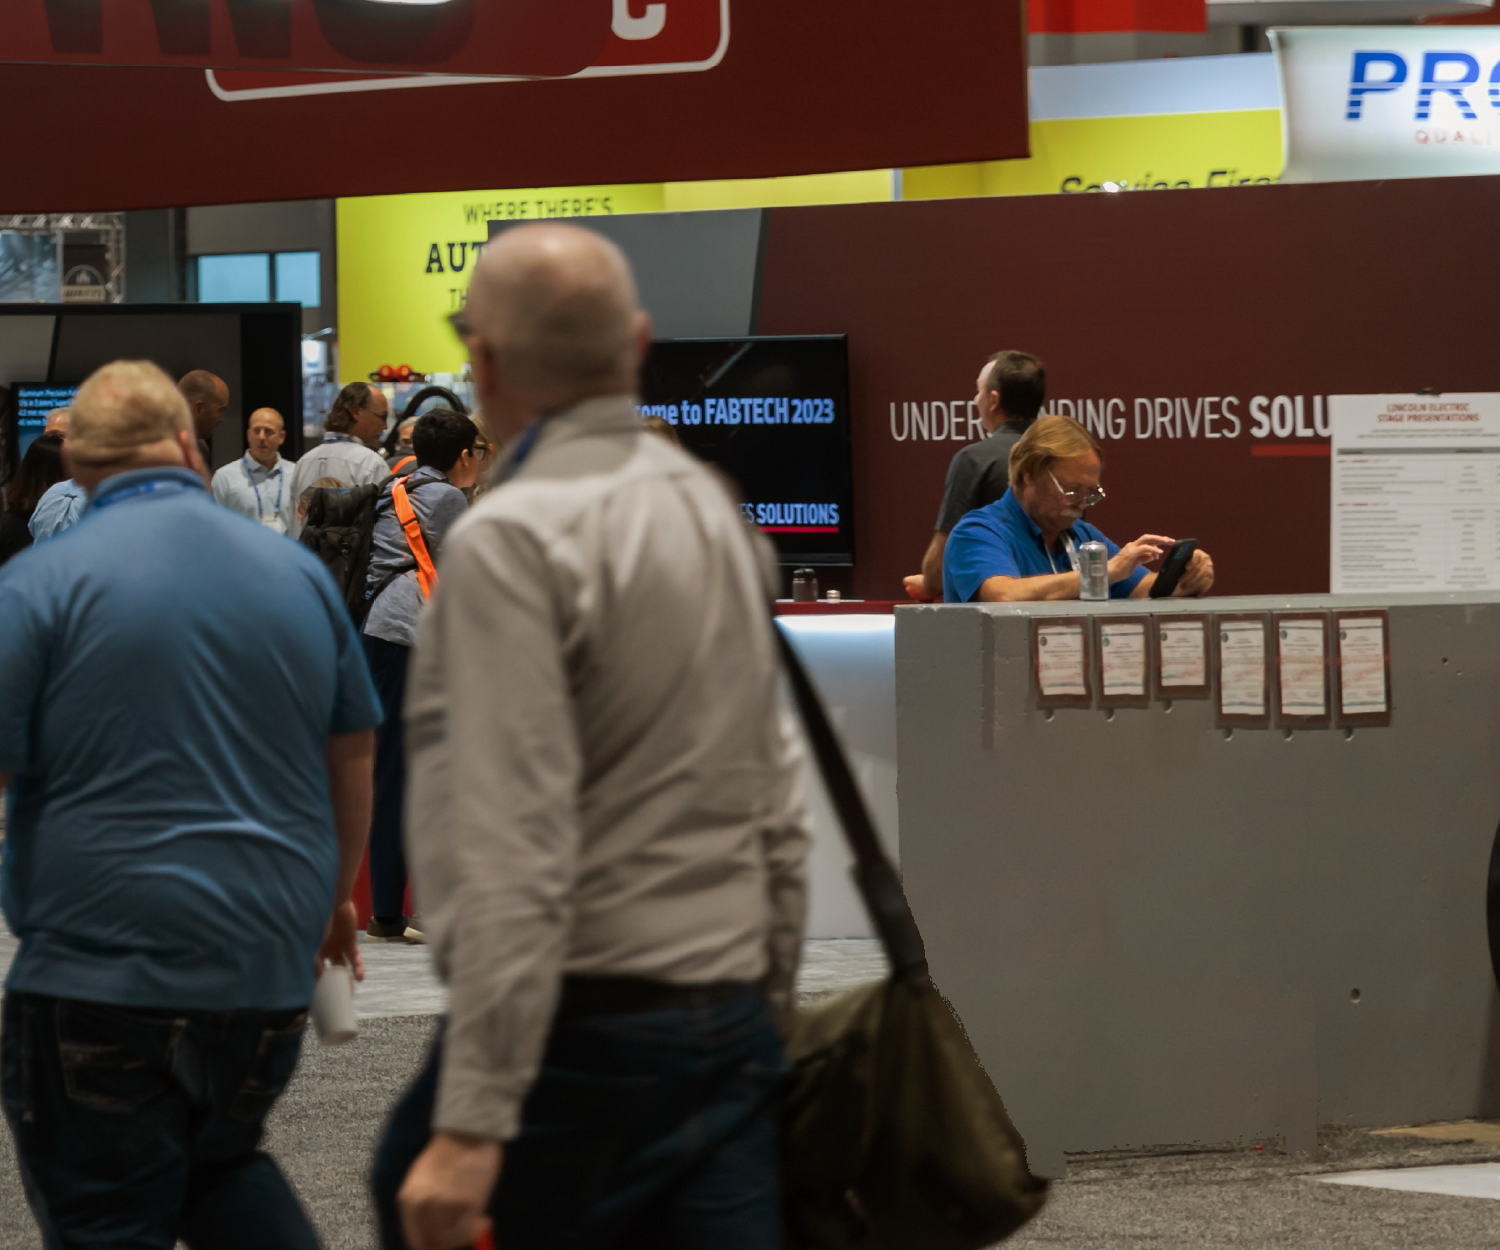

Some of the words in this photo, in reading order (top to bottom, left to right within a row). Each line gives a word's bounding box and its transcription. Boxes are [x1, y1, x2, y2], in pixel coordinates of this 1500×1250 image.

[1345, 49, 1500, 122] PR
[463, 201, 529, 225] WHERE
[535, 196, 614, 219] THERE'S
[681, 399, 702, 426] to
[704, 397, 789, 425] FABTECH
[791, 398, 836, 425] 2023
[889, 397, 1127, 442] UNDERNDING
[1134, 395, 1241, 440] DRIVES
[1377, 413, 1404, 423] STAGE
[1407, 413, 1480, 423] PRESENTATIONS
[1386, 403, 1427, 413] LINCOLN
[1429, 402, 1470, 412] ELECTRIC
[756, 502, 840, 525] SOLUTIONS
